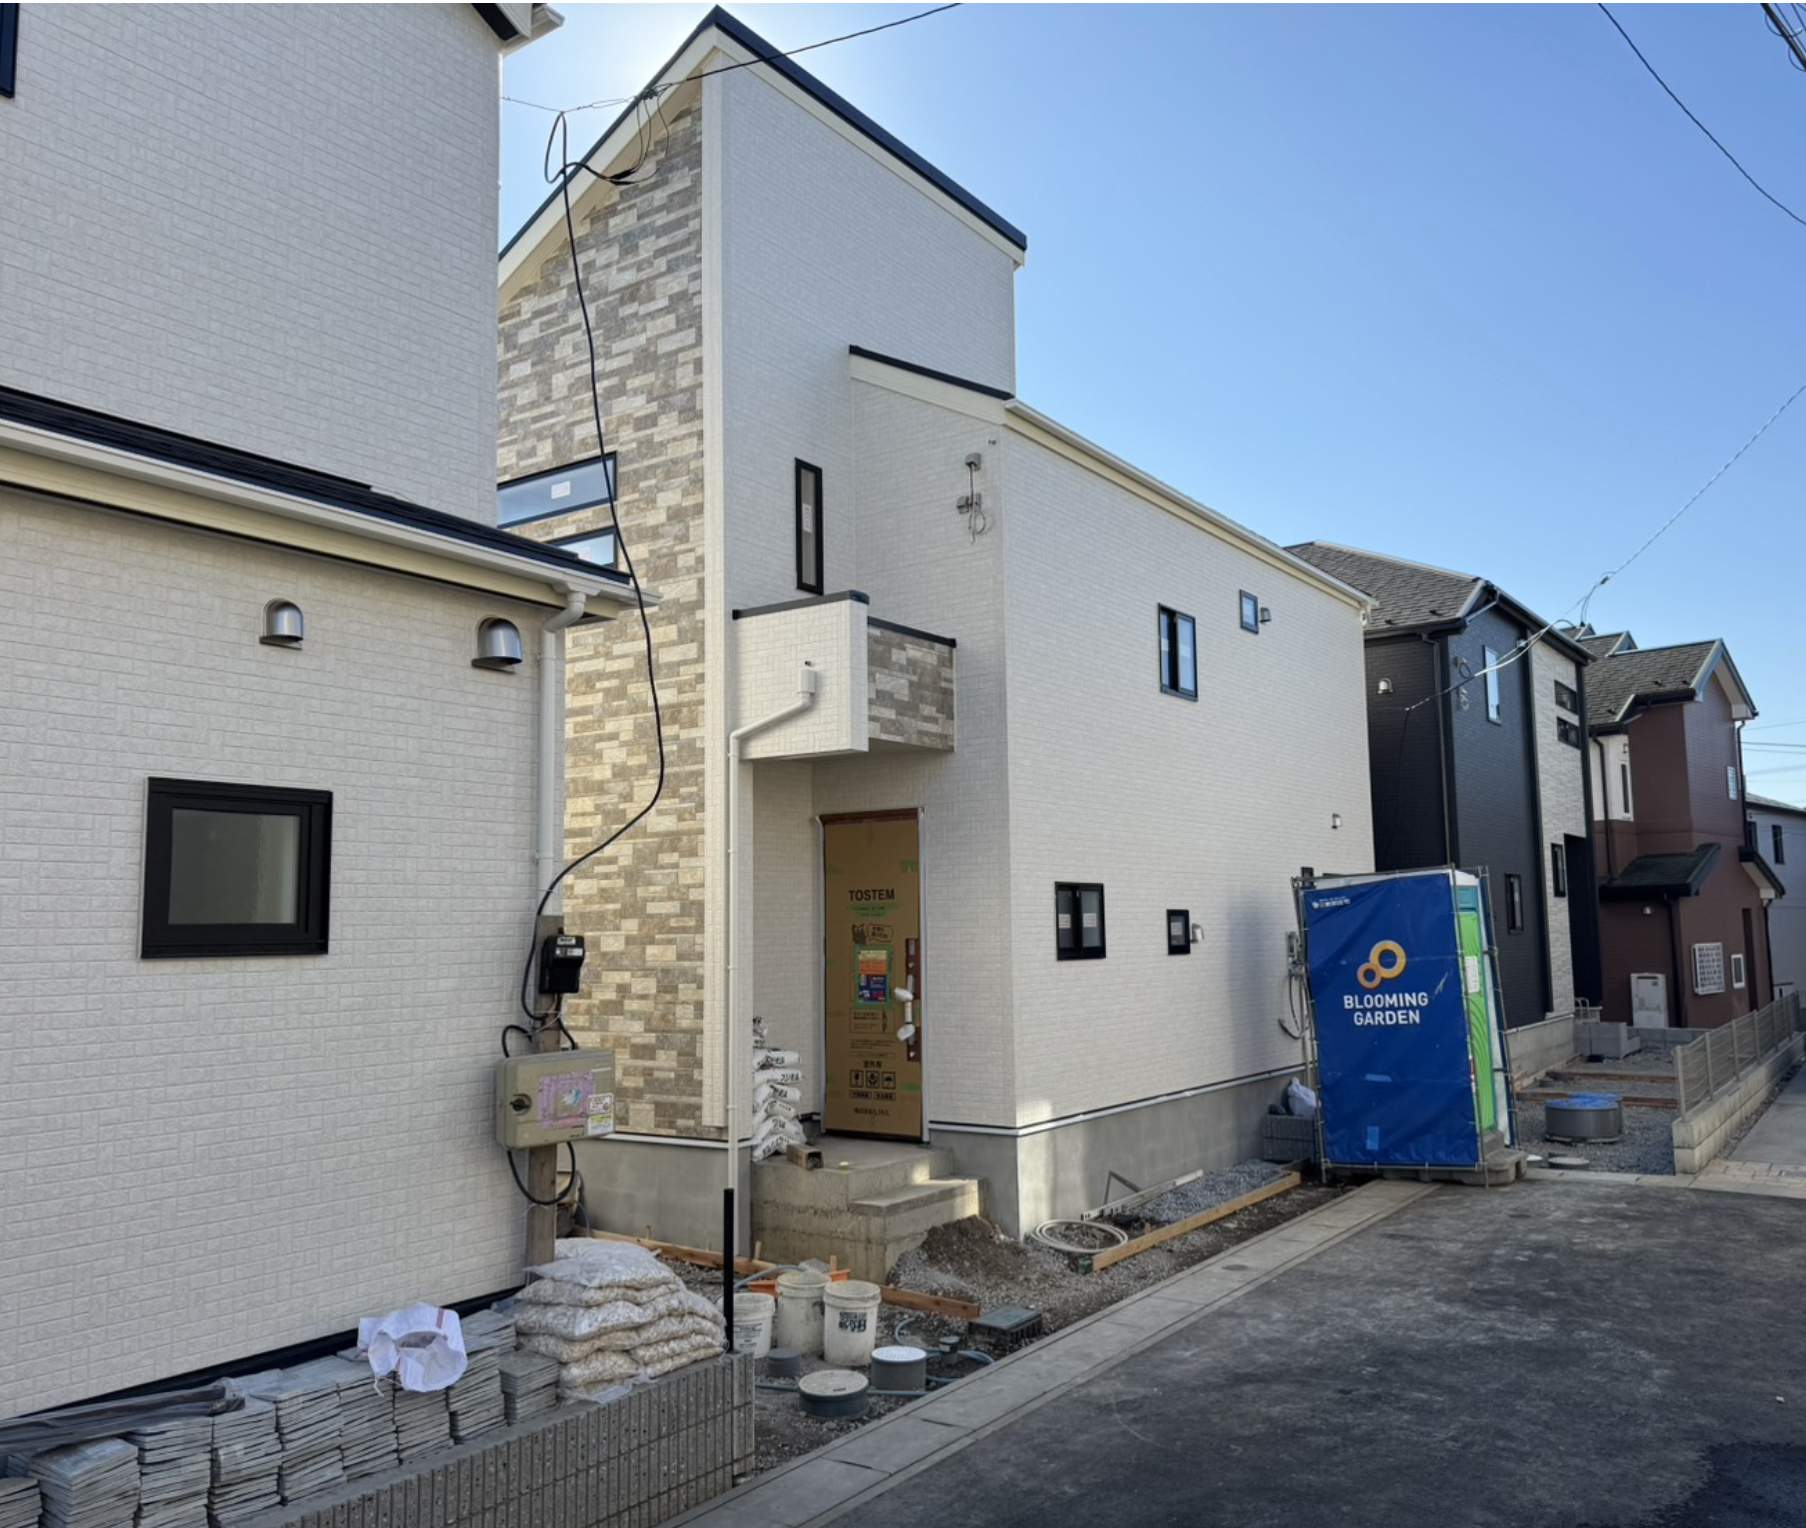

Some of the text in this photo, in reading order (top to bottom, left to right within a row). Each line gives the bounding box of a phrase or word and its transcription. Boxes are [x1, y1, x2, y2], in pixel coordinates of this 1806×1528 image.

[848, 888, 895, 902] TOSTEM
[1343, 992, 1429, 1010] BLOOMING
[1353, 1009, 1420, 1026] GARDEN
